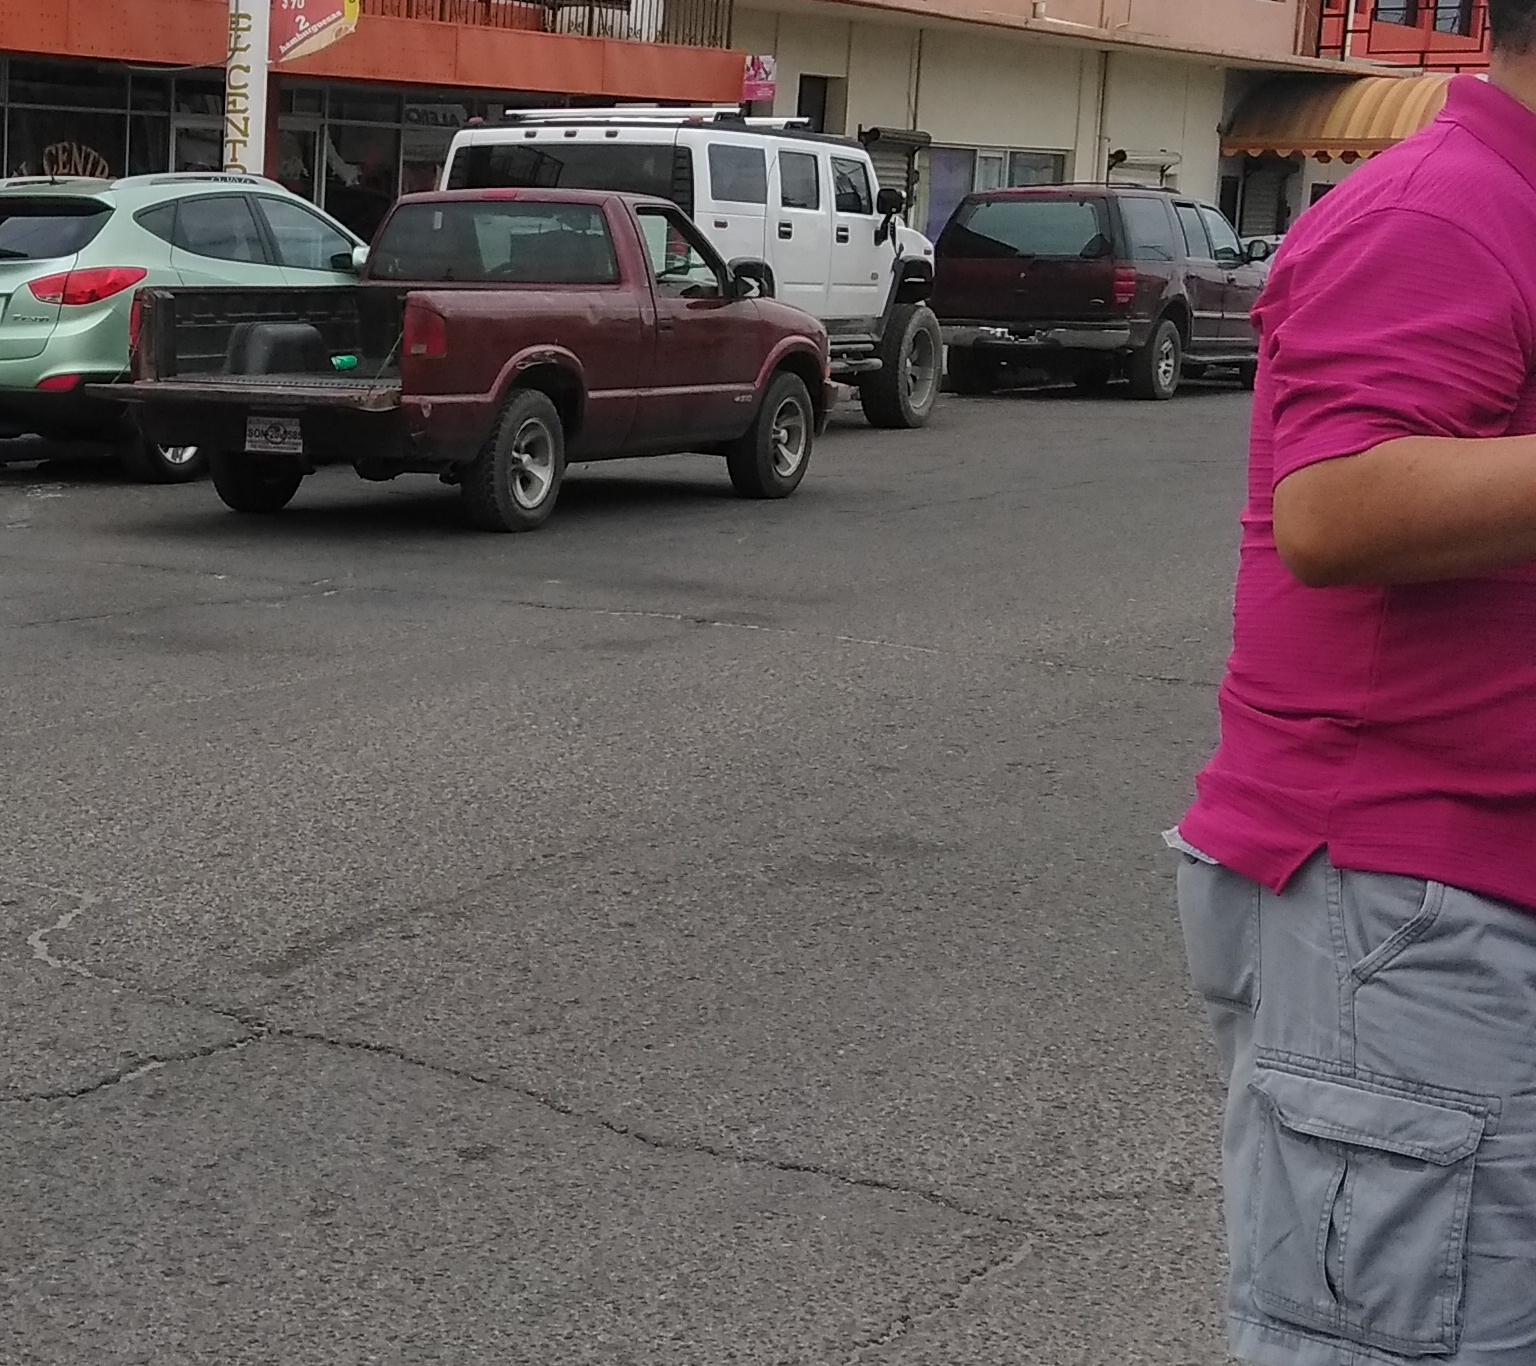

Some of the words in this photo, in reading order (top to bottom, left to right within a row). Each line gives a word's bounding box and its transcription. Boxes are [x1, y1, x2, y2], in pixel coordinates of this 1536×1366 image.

[228, 12, 252, 53] EL
[278, 10, 343, 54] hamburguesas
[294, 15, 310, 31] 2
